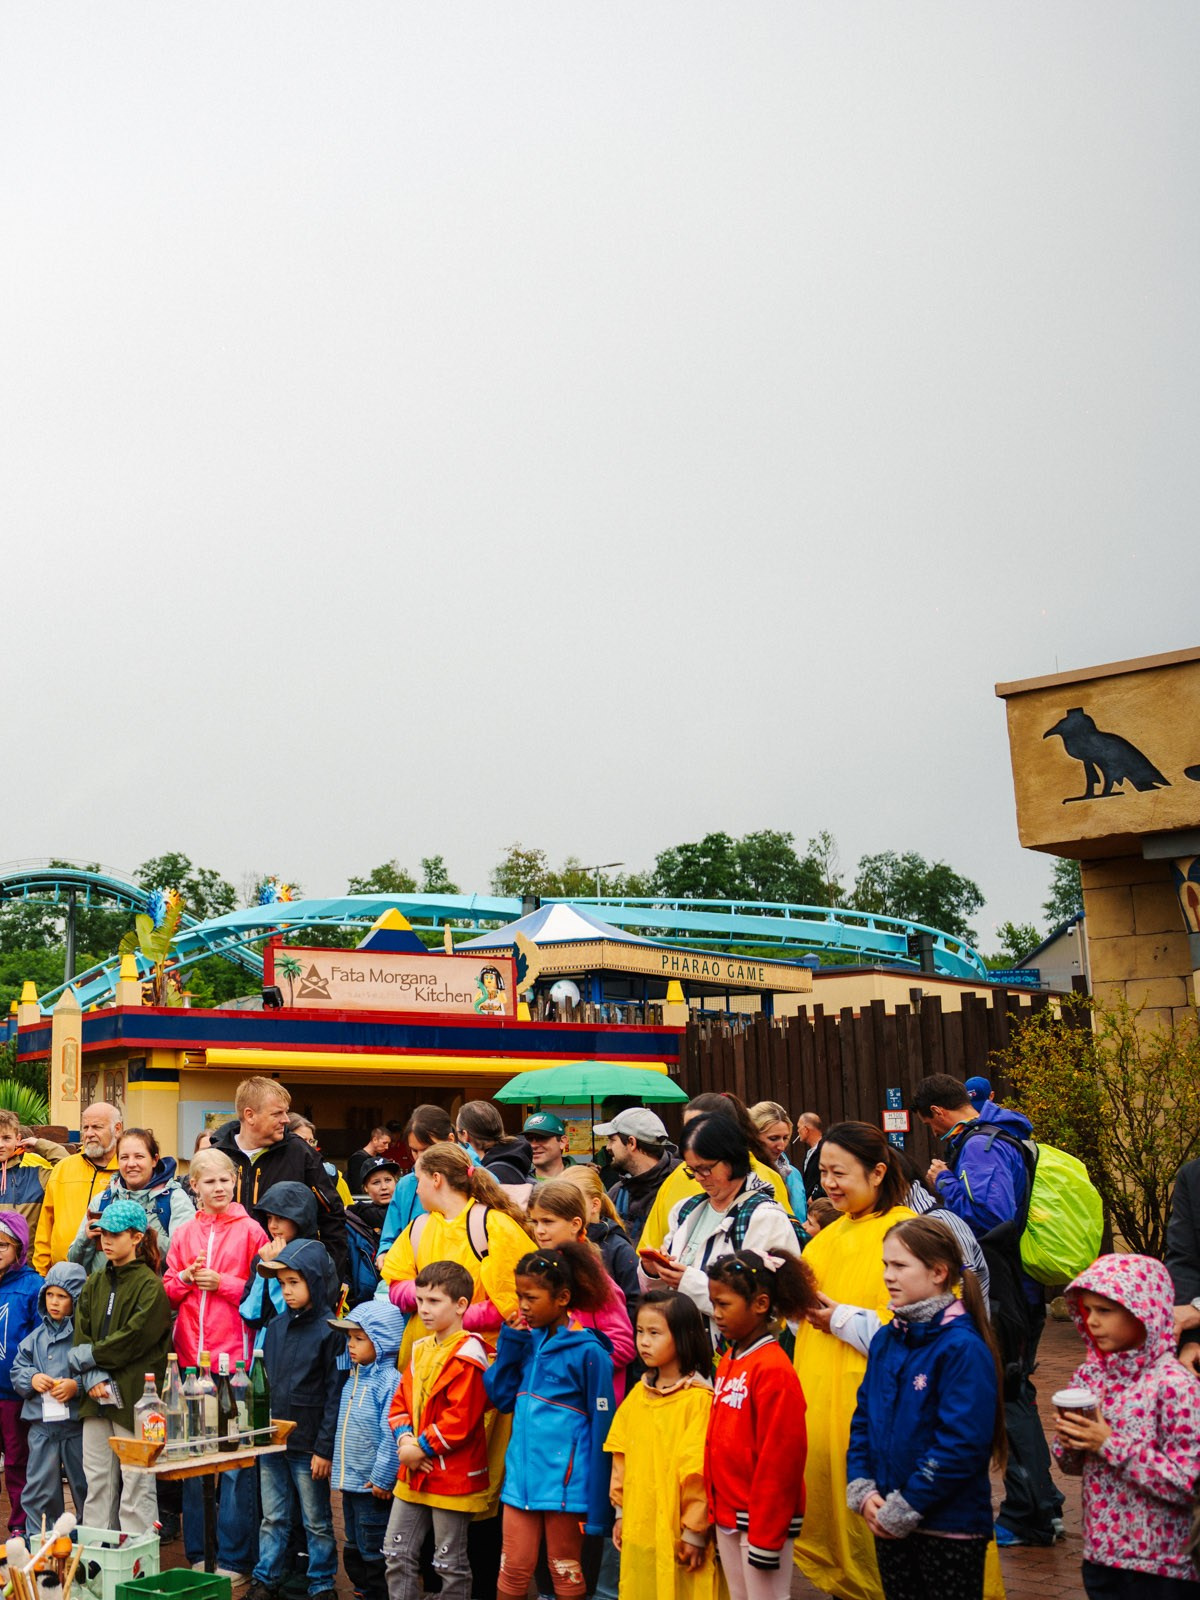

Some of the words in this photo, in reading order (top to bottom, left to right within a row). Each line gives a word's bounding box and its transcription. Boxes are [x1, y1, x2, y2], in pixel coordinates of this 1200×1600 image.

[331, 966, 365, 982] Fata
[369, 968, 437, 991] Morgana
[662, 955, 720, 976] PHARAO
[727, 964, 765, 982] GAME
[415, 983, 472, 1003] Kitchen
